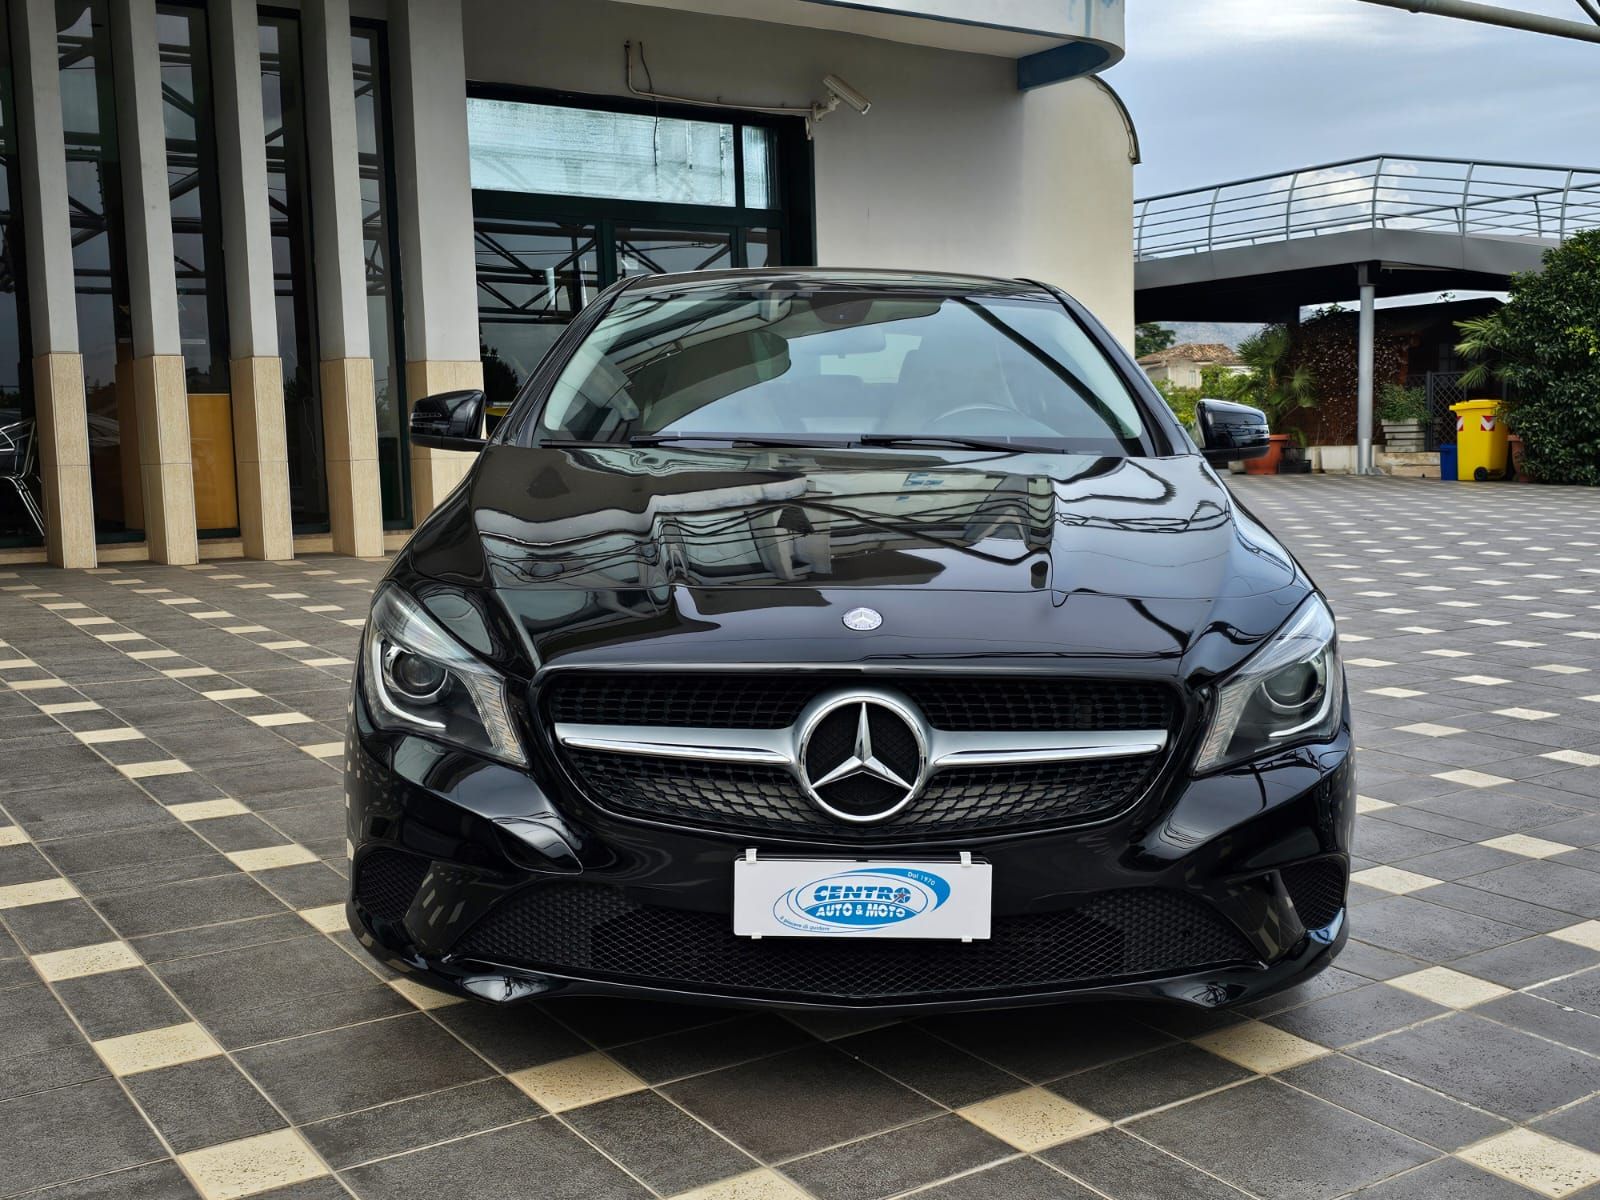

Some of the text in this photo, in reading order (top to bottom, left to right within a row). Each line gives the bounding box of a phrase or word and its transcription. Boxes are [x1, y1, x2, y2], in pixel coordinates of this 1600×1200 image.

[920, 874, 936, 886] 1970
[813, 885, 911, 903] CENTRO
[815, 903, 906, 918] AUTO & MOTO
